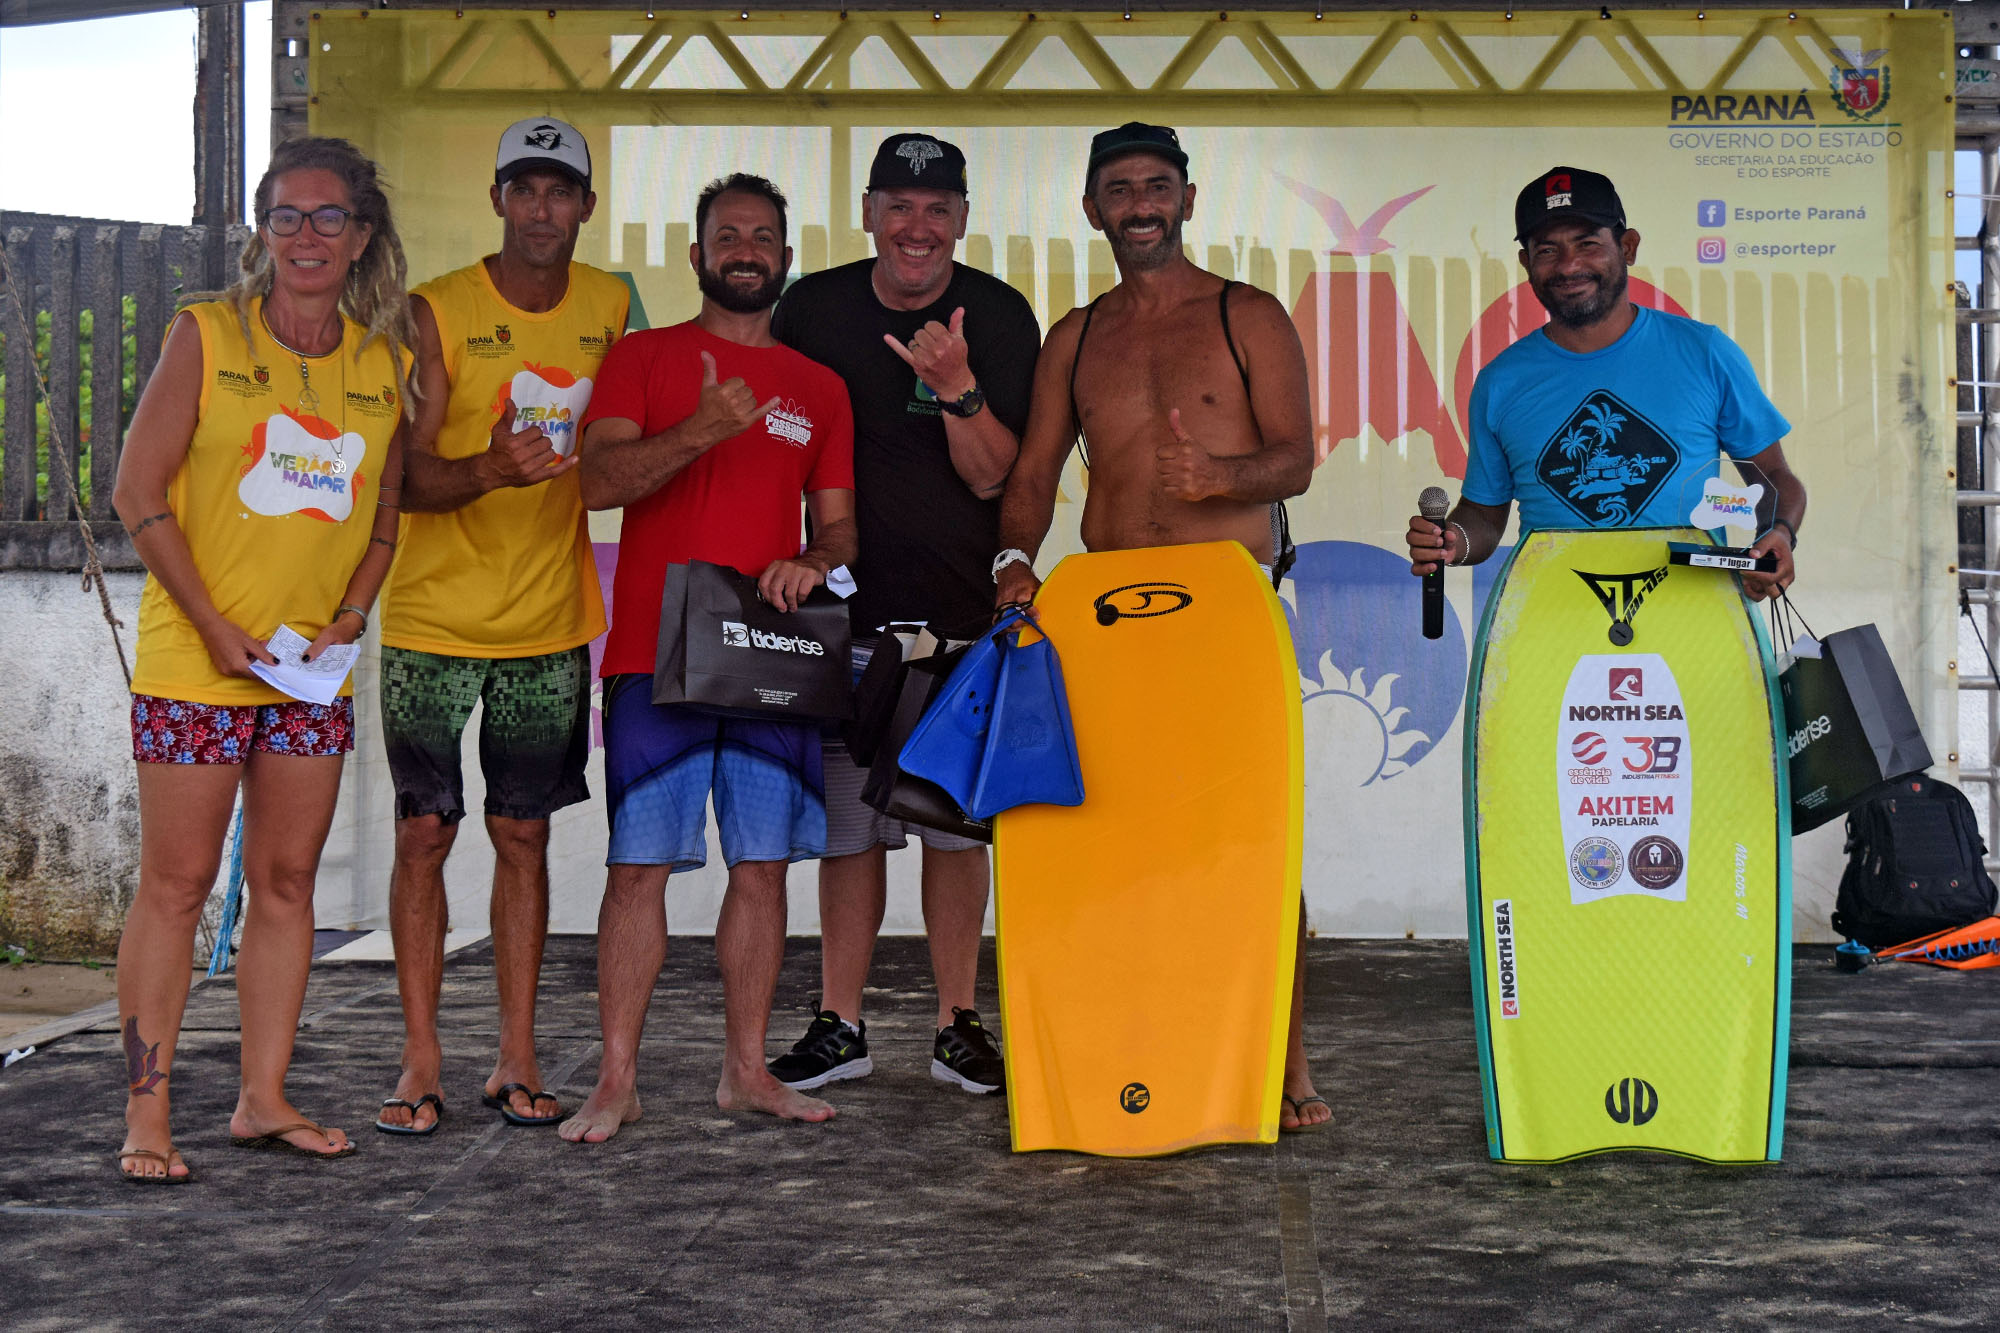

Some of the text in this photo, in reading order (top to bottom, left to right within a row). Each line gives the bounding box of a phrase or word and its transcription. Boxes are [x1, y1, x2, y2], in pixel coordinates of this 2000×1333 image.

[1671, 88, 1815, 121] PARANÁ
[1669, 131, 1903, 149] GOVERNO DO ESTADO
[1695, 152, 1875, 166] SECRETARIA DA EDUCAÇÃO
[1737, 167, 1831, 178] E DO ESPORTE
[1547, 198, 1572, 210] SEA
[1734, 206, 1866, 223] Esporte Paraná
[1734, 242, 1837, 258] @esportepr
[579, 335, 604, 344] PARANÁ
[218, 370, 251, 384] PARANÁ
[346, 392, 381, 403] PARANÁ
[1651, 456, 1667, 464] SEA
[1550, 466, 1575, 477] NORTH
[282, 469, 346, 494] MAIOR
[1705, 494, 1748, 506] VERÃO
[1712, 504, 1753, 516] MAIOR
[1727, 558, 1751, 568] lugar
[751, 628, 824, 656] tiderise
[1569, 705, 1683, 721] NORTH SEA
[1788, 715, 1831, 758] iderise
[1622, 737, 1681, 773] 3B
[1568, 767, 1612, 777] essência
[1570, 775, 1610, 784] de vida
[1577, 796, 1674, 815] AKITEM
[1592, 817, 1659, 826] PAPELARIA
[1734, 842, 1749, 920] Marcos M
[1496, 902, 1515, 998] NORTH SEA
